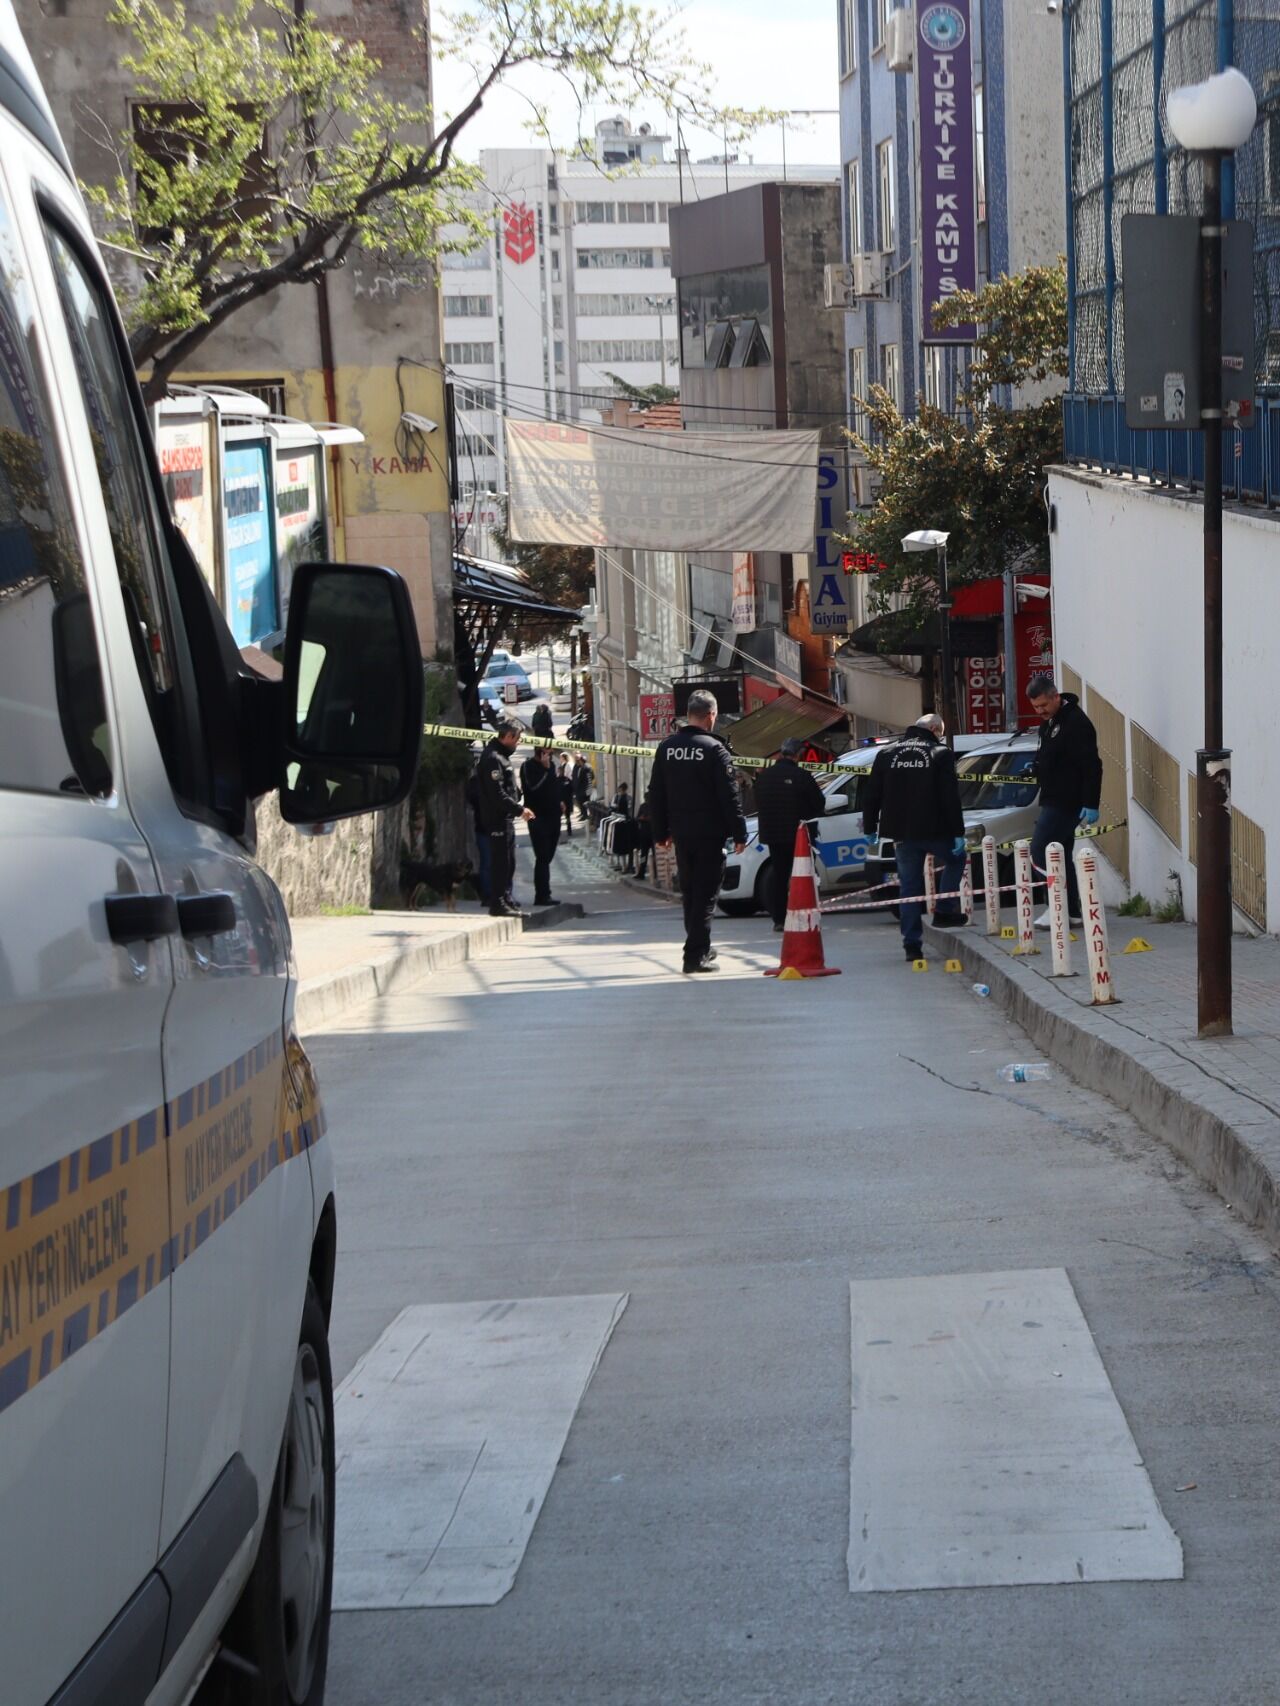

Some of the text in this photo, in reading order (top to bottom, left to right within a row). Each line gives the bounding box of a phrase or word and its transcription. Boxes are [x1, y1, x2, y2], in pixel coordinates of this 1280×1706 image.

[815, 456, 846, 606] SILA
[814, 612, 848, 628] Giyim
[970, 657, 985, 733] GÖZL
[666, 747, 705, 761] POLİS
[897, 759, 925, 769] POLİS
[1003, 929, 1014, 937] 10
